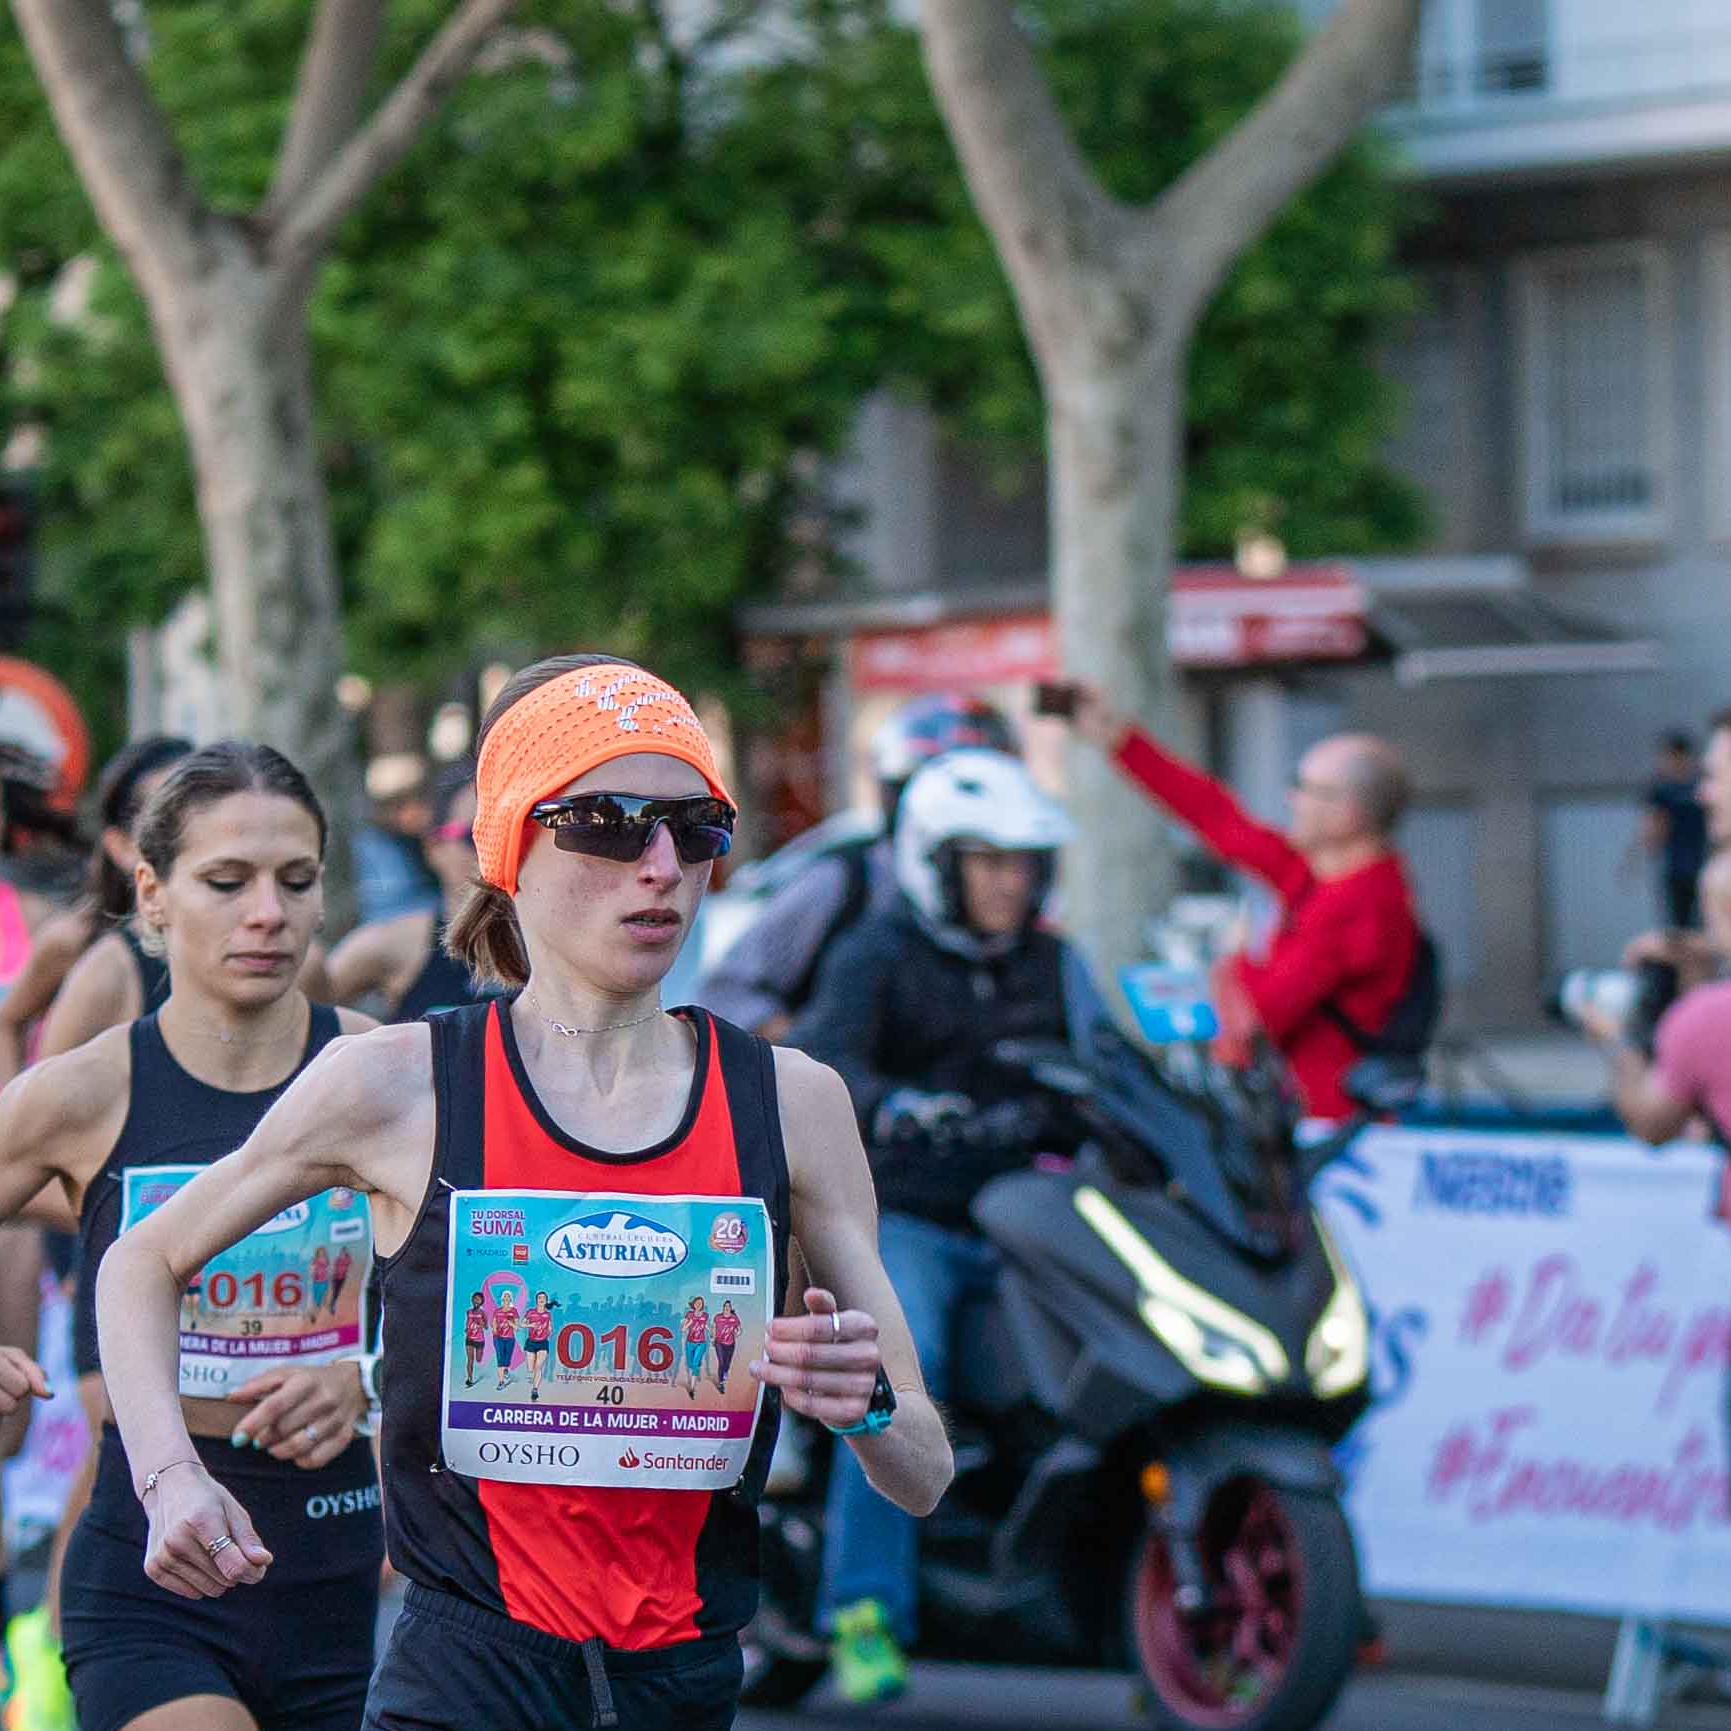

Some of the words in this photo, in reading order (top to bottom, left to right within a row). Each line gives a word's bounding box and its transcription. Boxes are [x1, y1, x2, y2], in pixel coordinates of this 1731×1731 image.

[471, 1210, 483, 1219] TU
[486, 1210, 525, 1220] DORSAL
[472, 1220, 524, 1236] SUMA
[716, 1218, 741, 1239] 20
[556, 1234, 677, 1262] ASTURIANA
[207, 1272, 302, 1308] 016
[241, 1320, 263, 1336] 39
[557, 1323, 674, 1372] 016
[181, 1365, 228, 1384] SHO
[596, 1385, 624, 1405] 40
[483, 1408, 554, 1425] CARRERA
[559, 1411, 578, 1427] DE
[583, 1412, 602, 1428] LA
[607, 1413, 658, 1429] MUJER
[672, 1415, 729, 1432] MADRID
[479, 1442, 580, 1467] OYSHO
[643, 1452, 729, 1471] Santander
